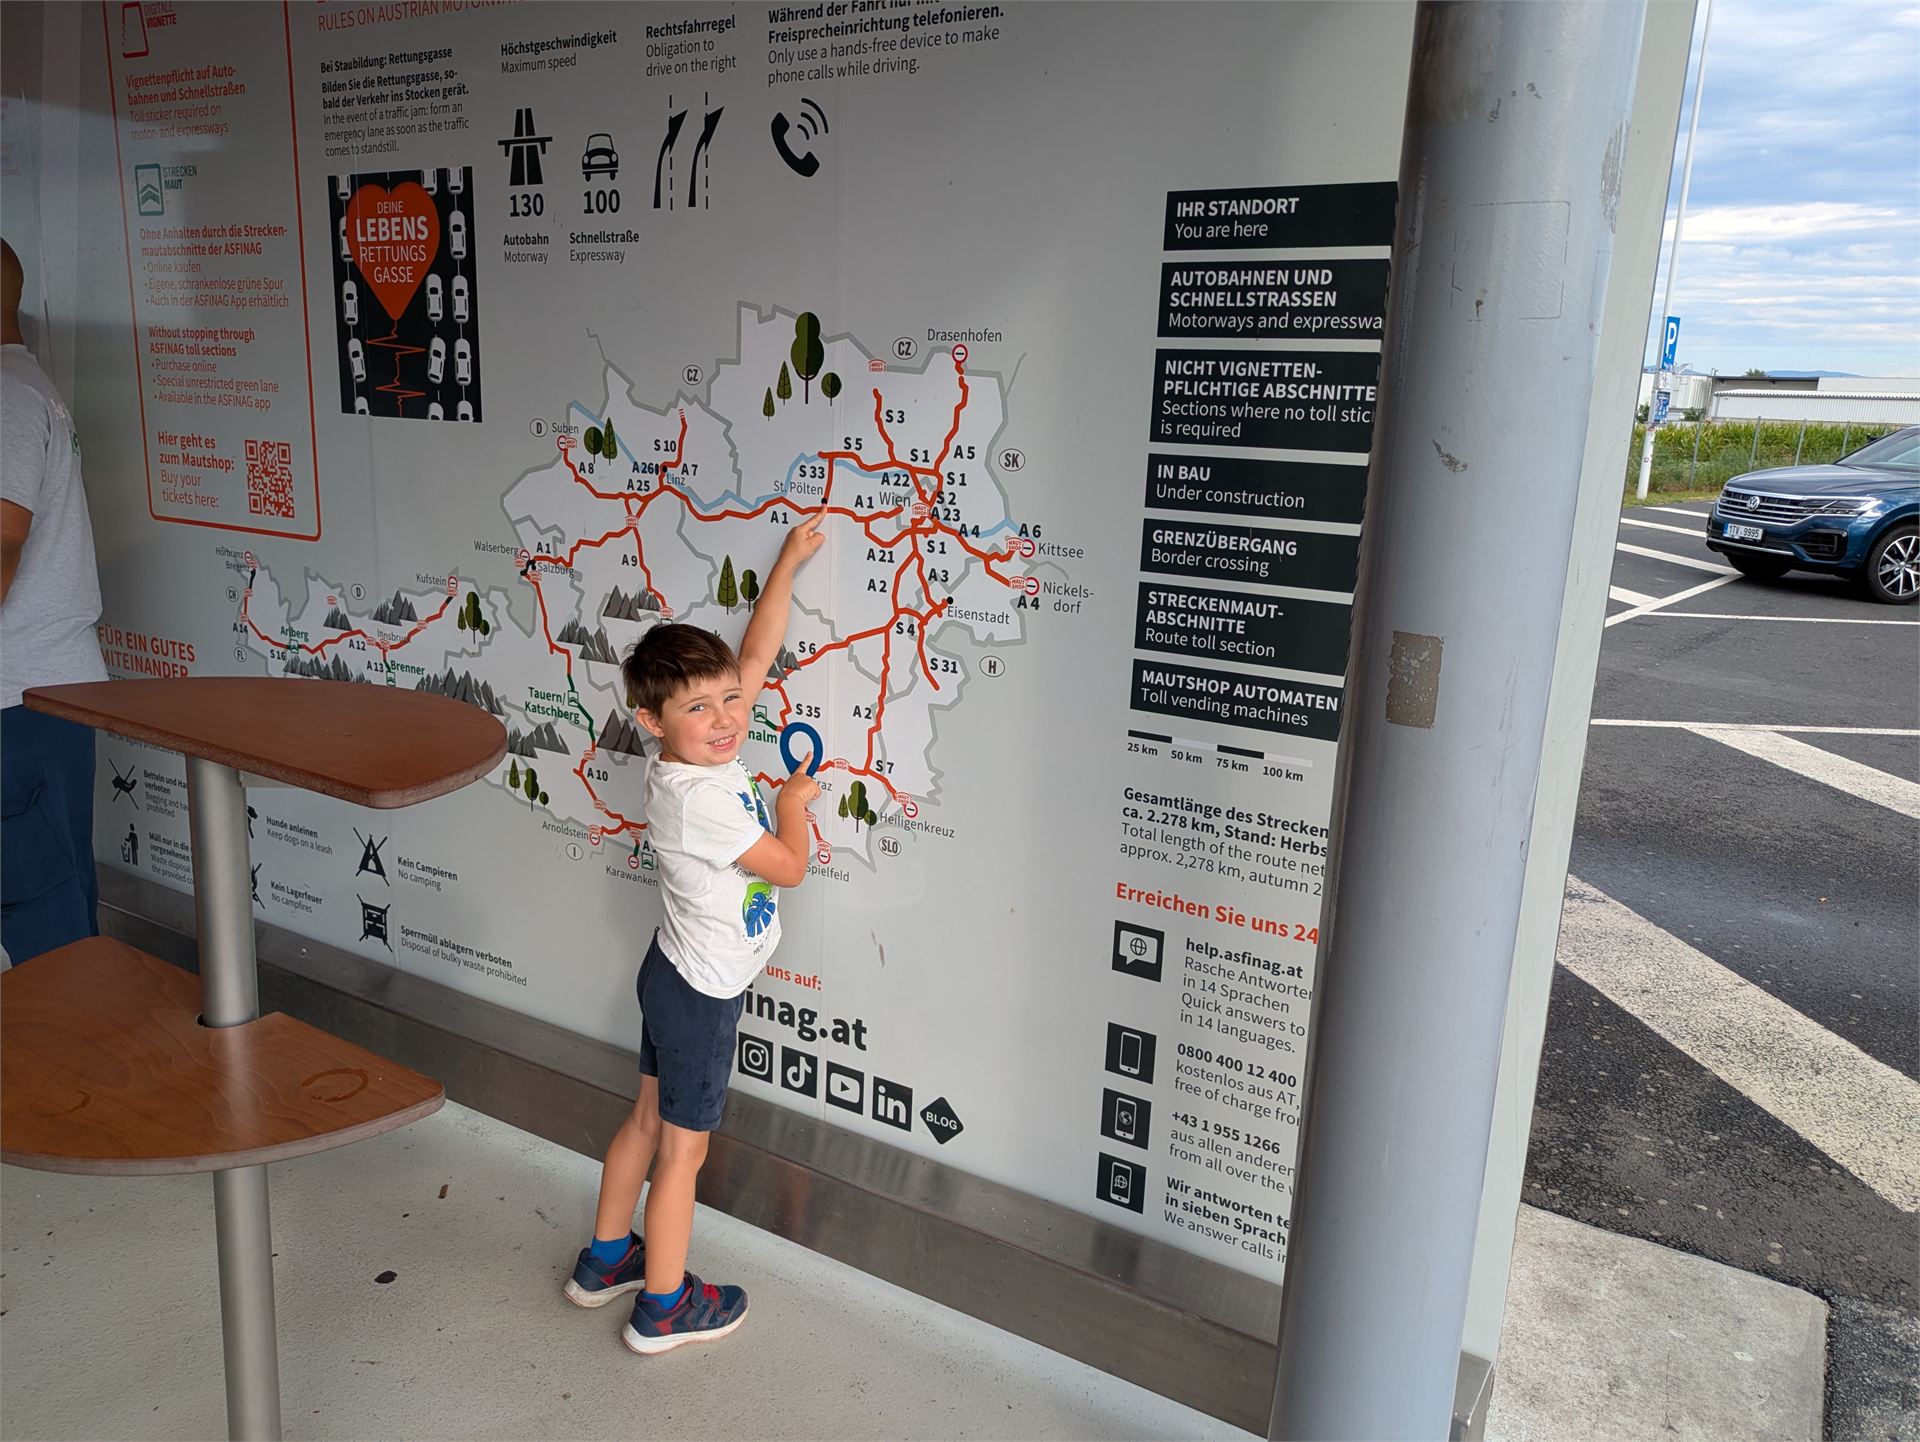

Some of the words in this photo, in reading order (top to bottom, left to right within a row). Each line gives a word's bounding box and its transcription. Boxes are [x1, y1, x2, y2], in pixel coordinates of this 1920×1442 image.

[319, 11, 355, 32] RULES
[358, 9, 375, 26] ON
[378, 1, 439, 23] AUSTRIAN
[769, 4, 823, 24] Während
[827, 2, 847, 17] der
[646, 15, 735, 39] Rechtsfahrregel
[769, 16, 910, 44] Freisprecheinrichtung
[913, 5, 1004, 27] telefonieren.
[501, 30, 617, 56] Höchstgeschwindigkeit
[646, 42, 699, 60] Obligation
[703, 39, 714, 51] to
[769, 50, 794, 66] Only
[798, 48, 818, 61] use
[821, 48, 827, 59] a
[830, 37, 897, 58] hands-free
[901, 33, 941, 50] device
[945, 33, 958, 45] to
[962, 25, 999, 44] make
[321, 62, 333, 73] Bei
[335, 56, 387, 72] Staubildung:
[389, 48, 452, 65] Rettungsgasse
[501, 60, 546, 74] Maximum
[549, 53, 577, 71] speed
[646, 62, 672, 77] drive
[674, 61, 687, 74] on
[691, 59, 708, 72] the
[711, 56, 736, 73] right
[126, 68, 194, 90] Vignettenpflicht
[196, 66, 210, 79] auf
[212, 65, 236, 78] Auto-
[377, 201, 403, 214] DEINE
[510, 193, 544, 217] 130
[584, 189, 620, 214] 100
[1176, 202, 1204, 217] IHR
[1208, 198, 1299, 216] STANDORT
[356, 216, 429, 242] LEBENS
[504, 233, 549, 245] Autobahn
[570, 230, 639, 244] Schnellstraße
[1176, 223, 1202, 238] You
[1206, 224, 1230, 237] are
[1234, 221, 1268, 236] here
[361, 245, 426, 263] RETTUNGS
[504, 251, 548, 264] Motorway
[570, 250, 625, 264] Expressway
[374, 266, 414, 283] GASSE
[1171, 270, 1289, 286] AUTOBAHNEN
[1294, 270, 1332, 285] UND
[1170, 292, 1336, 307] SCHNELLSTRASSEN
[1169, 313, 1254, 332] Motorways
[1258, 312, 1288, 328] and
[148, 326, 180, 338] Without
[182, 327, 218, 342] stopping
[220, 328, 254, 343] through
[927, 329, 1002, 342] Drasenhofen
[1666, 322, 1677, 356] P
[898, 341, 911, 356] CZ
[686, 368, 698, 382] CZ
[1165, 360, 1216, 376] NICHT
[1220, 362, 1322, 378] VIGNETTEN-
[1164, 381, 1260, 398] PFLICHTIGE
[1264, 382, 1376, 402] ABSCHNITTE
[1162, 400, 1226, 417] Sections
[1231, 403, 1280, 420] where
[1284, 406, 1304, 420] no
[1310, 405, 1336, 422] toll
[552, 423, 578, 434] Suben
[1161, 420, 1172, 434] is
[1176, 421, 1241, 439] required
[158, 432, 177, 447] Hier
[180, 434, 201, 450] geht
[205, 438, 216, 448] es
[160, 455, 180, 467] zum
[182, 454, 235, 473] Mautshop:
[1004, 454, 1019, 467] SK
[666, 474, 686, 486] Linz
[1158, 464, 1174, 479] IN
[1178, 466, 1210, 482] BAU
[789, 482, 823, 496] Pölten
[1156, 484, 1202, 500] Under
[1206, 488, 1304, 508] construction
[880, 492, 911, 508] Wien
[474, 541, 518, 556] Walserberg
[1038, 543, 1084, 558] Kittsee
[1152, 530, 1297, 556] GRENZÜBERGANG
[538, 562, 574, 578] Salzburg
[1152, 549, 1202, 566] Border
[1205, 554, 1269, 578] crossing
[416, 574, 447, 586] Kufstein
[1043, 582, 1094, 598] Nickels-
[1053, 599, 1081, 613] dorf
[1148, 592, 1284, 618] STRECKENMAUT-
[947, 606, 1010, 625] Eisenstadt
[1146, 610, 1246, 634] ABSCHNITTE
[280, 626, 309, 642] Arlberg
[1146, 628, 1188, 647] Route
[1192, 634, 1216, 650] toll
[1220, 640, 1275, 658] section
[126, 634, 148, 652] EIN
[151, 636, 196, 662] GUTES
[390, 661, 425, 675] Brenner
[528, 686, 566, 706] Tauern/
[1142, 670, 1230, 694] MAUTSHOP
[1233, 683, 1338, 712] AUTOMATEN
[525, 701, 580, 724] Katschberg
[1142, 688, 1168, 704] Toll
[1172, 693, 1230, 718] vending
[1234, 700, 1308, 726] machines
[1127, 743, 1140, 752] 25
[1142, 744, 1158, 755] km
[1263, 766, 1283, 778] 100
[1285, 769, 1303, 782] km
[1124, 787, 1222, 818] Gesamtlänge
[1225, 805, 1253, 823] des
[266, 816, 287, 832] Hunde
[289, 823, 318, 838] anleinen
[543, 821, 589, 840] Arnoldstein
[880, 812, 955, 838] Heiligenkreuz
[881, 838, 898, 854] SLO
[1122, 822, 1157, 841] Total
[1161, 828, 1205, 851] length
[1210, 838, 1224, 855] of
[1228, 844, 1251, 861] the
[1256, 851, 1296, 871] route
[398, 856, 414, 868] Kein
[416, 861, 458, 881] Campieren
[606, 866, 658, 887] Karawanken
[271, 880, 285, 892] Kein
[286, 886, 322, 905] Lagerfeuer
[1116, 883, 1209, 919] Erreichen
[1215, 906, 1246, 927] Sie
[1251, 916, 1288, 937] uns
[1186, 938, 1303, 979] help.asfinag.at
[767, 965, 790, 981] uns
[794, 974, 822, 990] auf:
[1177, 1043, 1212, 1062] 0800
[1216, 1054, 1243, 1072] 400
[1247, 1063, 1265, 1078] 12
[1268, 1070, 1297, 1088] 400
[925, 1112, 957, 1130] BLOG
[1172, 1111, 1198, 1128] +43
[1202, 1120, 1209, 1132] 1
[1214, 1124, 1240, 1142] 955
[1244, 1134, 1280, 1154] 1266
[1167, 1176, 1191, 1194] Wir
[1194, 1186, 1272, 1223] antworten
